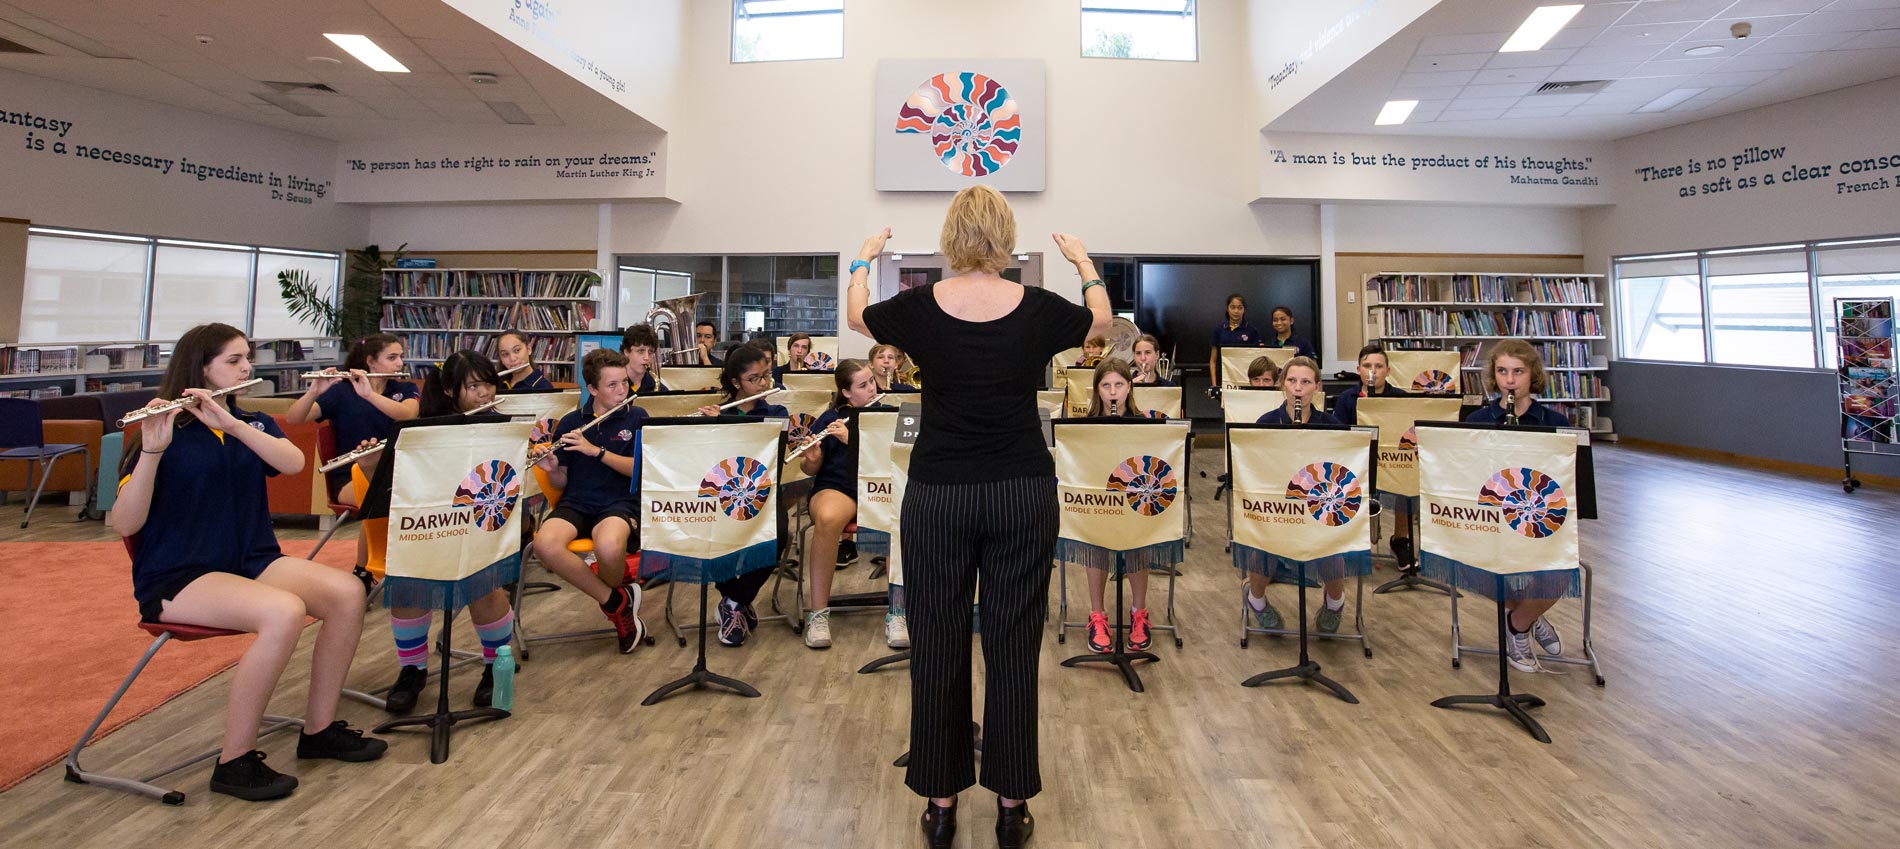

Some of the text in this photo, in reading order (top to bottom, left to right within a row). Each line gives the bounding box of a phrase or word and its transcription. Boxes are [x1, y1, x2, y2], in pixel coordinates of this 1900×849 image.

[26, 131, 331, 198] is a necessary ingredient in living."
[346, 151, 656, 173] "No person has the right to rain on your dreams."
[1270, 150, 1592, 174] "A man is but the product of his thoughts."
[1635, 146, 1786, 182] "There is no pillow
[556, 168, 655, 179] Martin Luther King Jr
[1510, 175, 1599, 186] Mahatma Gandhi
[1679, 184, 1697, 198] as
[1702, 176, 1732, 195] soft
[1737, 175, 1757, 189] as
[1763, 173, 1775, 186] a
[1782, 164, 1832, 183] clear
[1836, 177, 1890, 194] French
[271, 190, 313, 205] Dr Seuss
[903, 417, 915, 426] 9
[651, 500, 717, 513] DARWIN
[1064, 492, 1124, 507] DARWIN
[1242, 498, 1305, 515] DARWIN
[1064, 505, 1125, 516] MIDDLE SCHOOL
[1243, 512, 1306, 524] MIDDLE SCHOOL
[1430, 502, 1500, 524] DARWIN
[400, 510, 471, 530] DARWIN
[651, 515, 717, 523] MIDDLE SCHOOL
[1431, 517, 1502, 533] MIDDLE SCHOOL
[399, 527, 469, 541] MIDDLE SCHOOL
